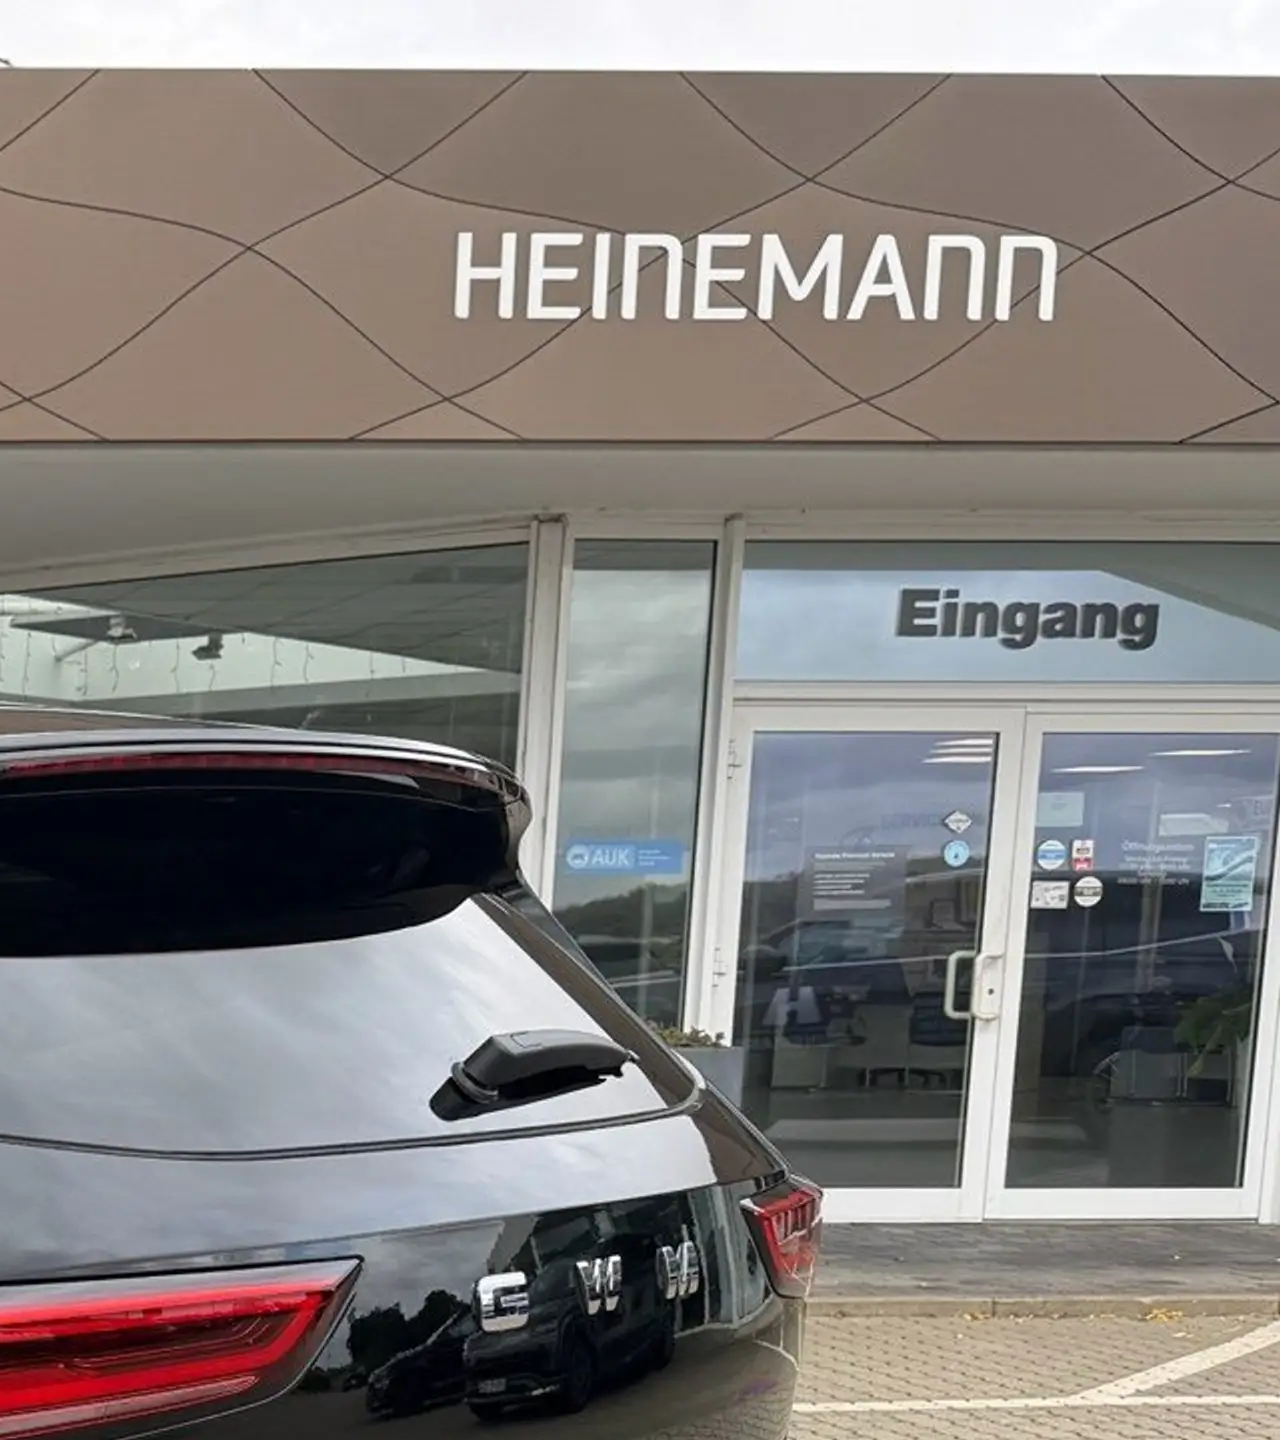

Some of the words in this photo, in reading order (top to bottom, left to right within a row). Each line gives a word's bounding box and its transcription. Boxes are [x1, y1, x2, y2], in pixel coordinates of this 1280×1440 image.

[453, 231, 1059, 321] HEINEMANN
[895, 588, 1161, 651] Eingang
[592, 849, 631, 865] AUK
